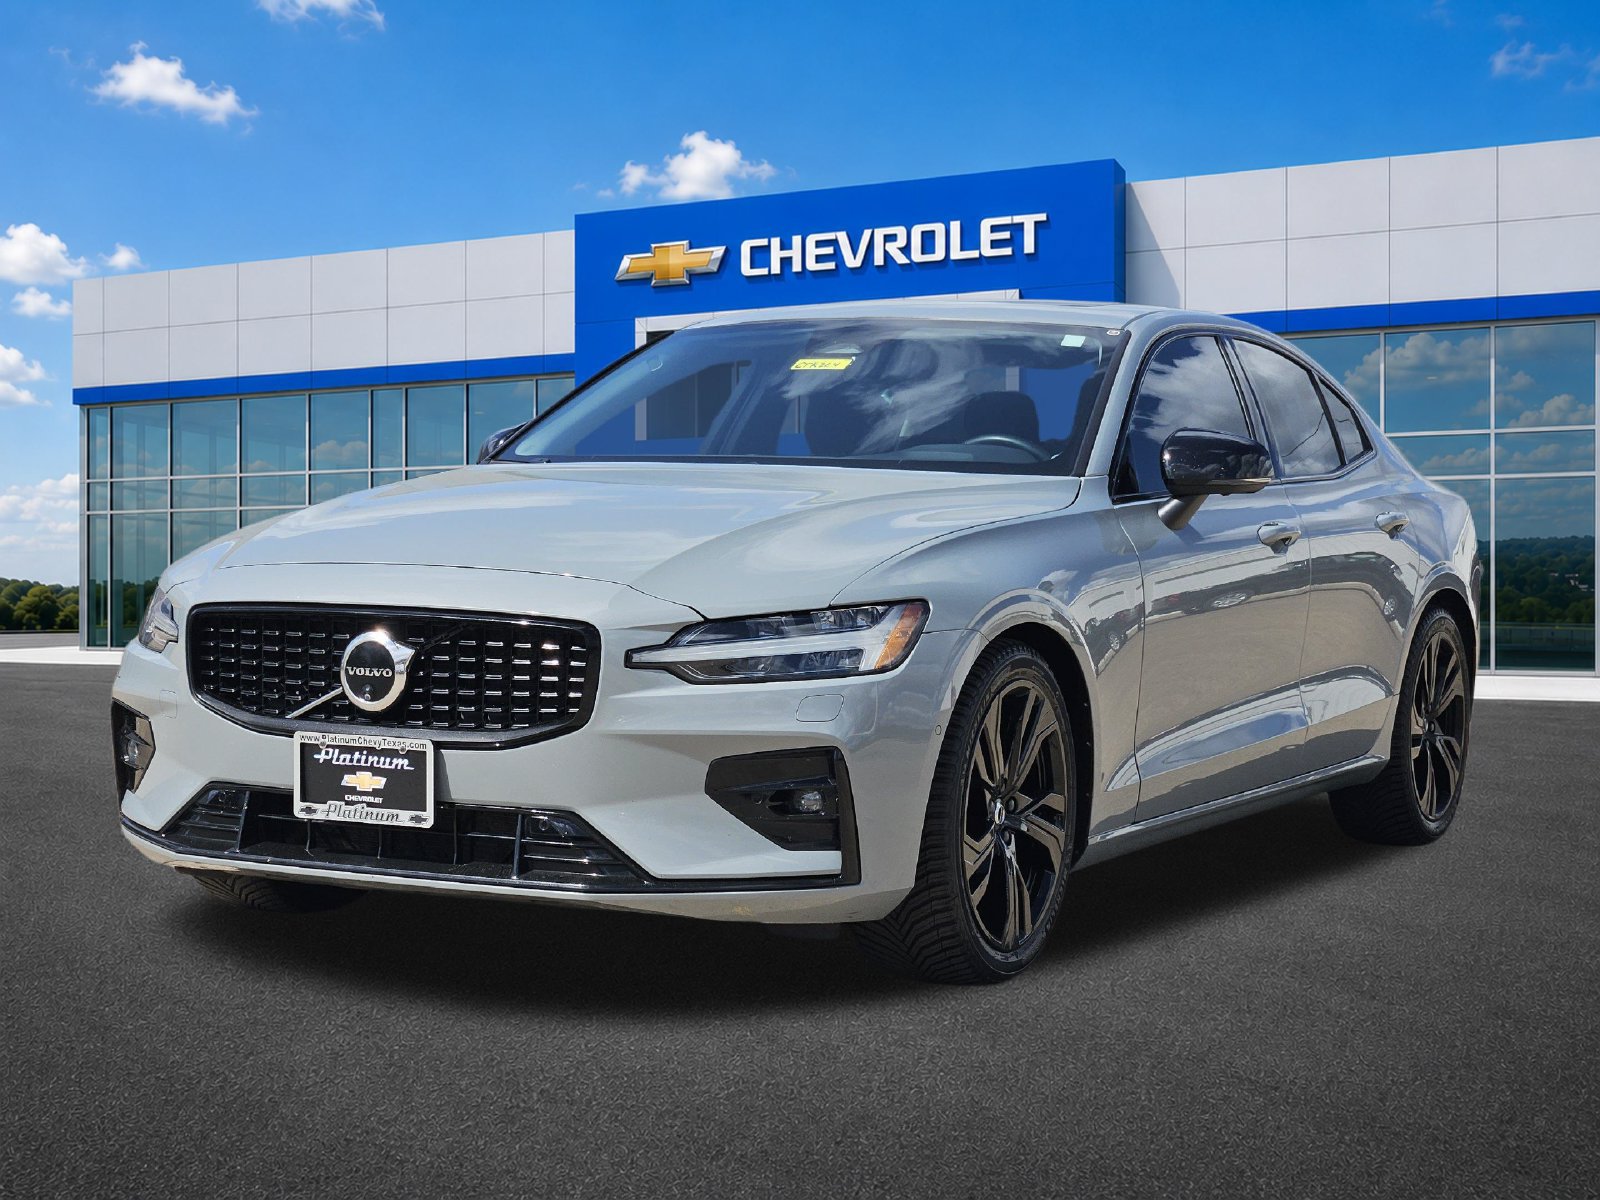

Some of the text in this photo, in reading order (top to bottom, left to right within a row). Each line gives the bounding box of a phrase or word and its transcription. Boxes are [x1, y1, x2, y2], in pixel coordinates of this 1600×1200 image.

[740, 213, 1047, 276] CHEVROLET
[346, 666, 393, 678] VOLVO
[299, 734, 427, 750] www.PlatinumChevyTexas.com
[313, 747, 414, 770] Platinum
[345, 794, 383, 804] CHEVROLET
[321, 803, 403, 823] Platinum
